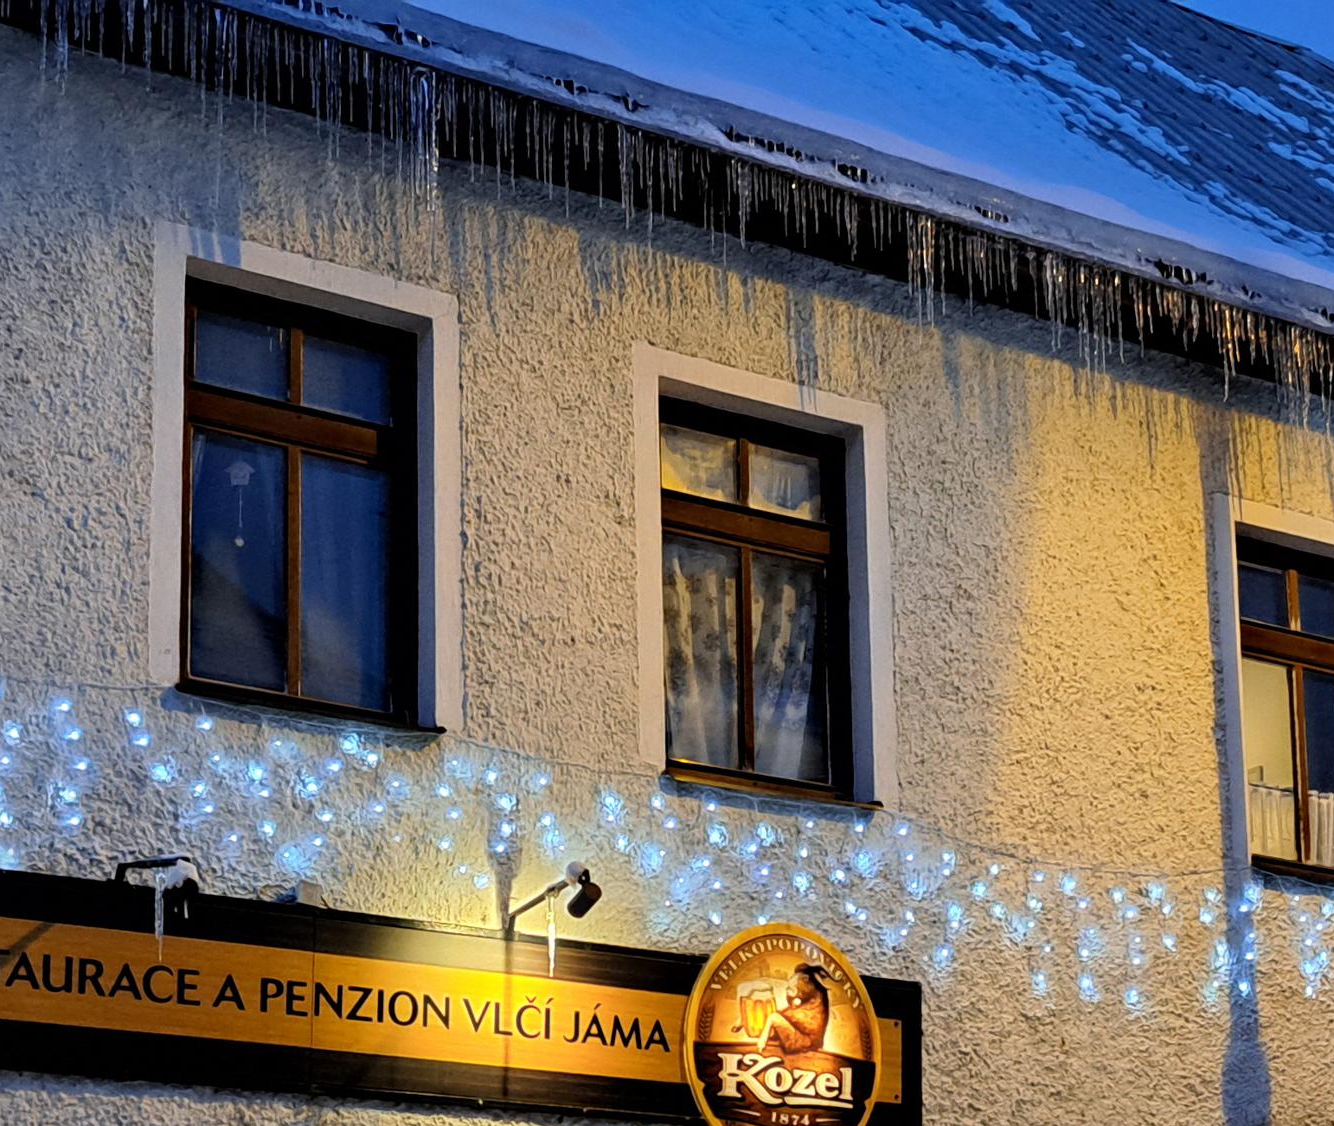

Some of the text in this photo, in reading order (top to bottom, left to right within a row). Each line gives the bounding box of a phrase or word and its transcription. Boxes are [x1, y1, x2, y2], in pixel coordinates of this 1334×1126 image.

[212, 974, 246, 1011] A
[259, 977, 450, 1030] PENZION
[462, 994, 554, 1041] VLČÍ
[563, 1003, 671, 1054] JÁMA
[717, 1053, 854, 1109] Kozel
[771, 1112, 811, 1126] 1874
